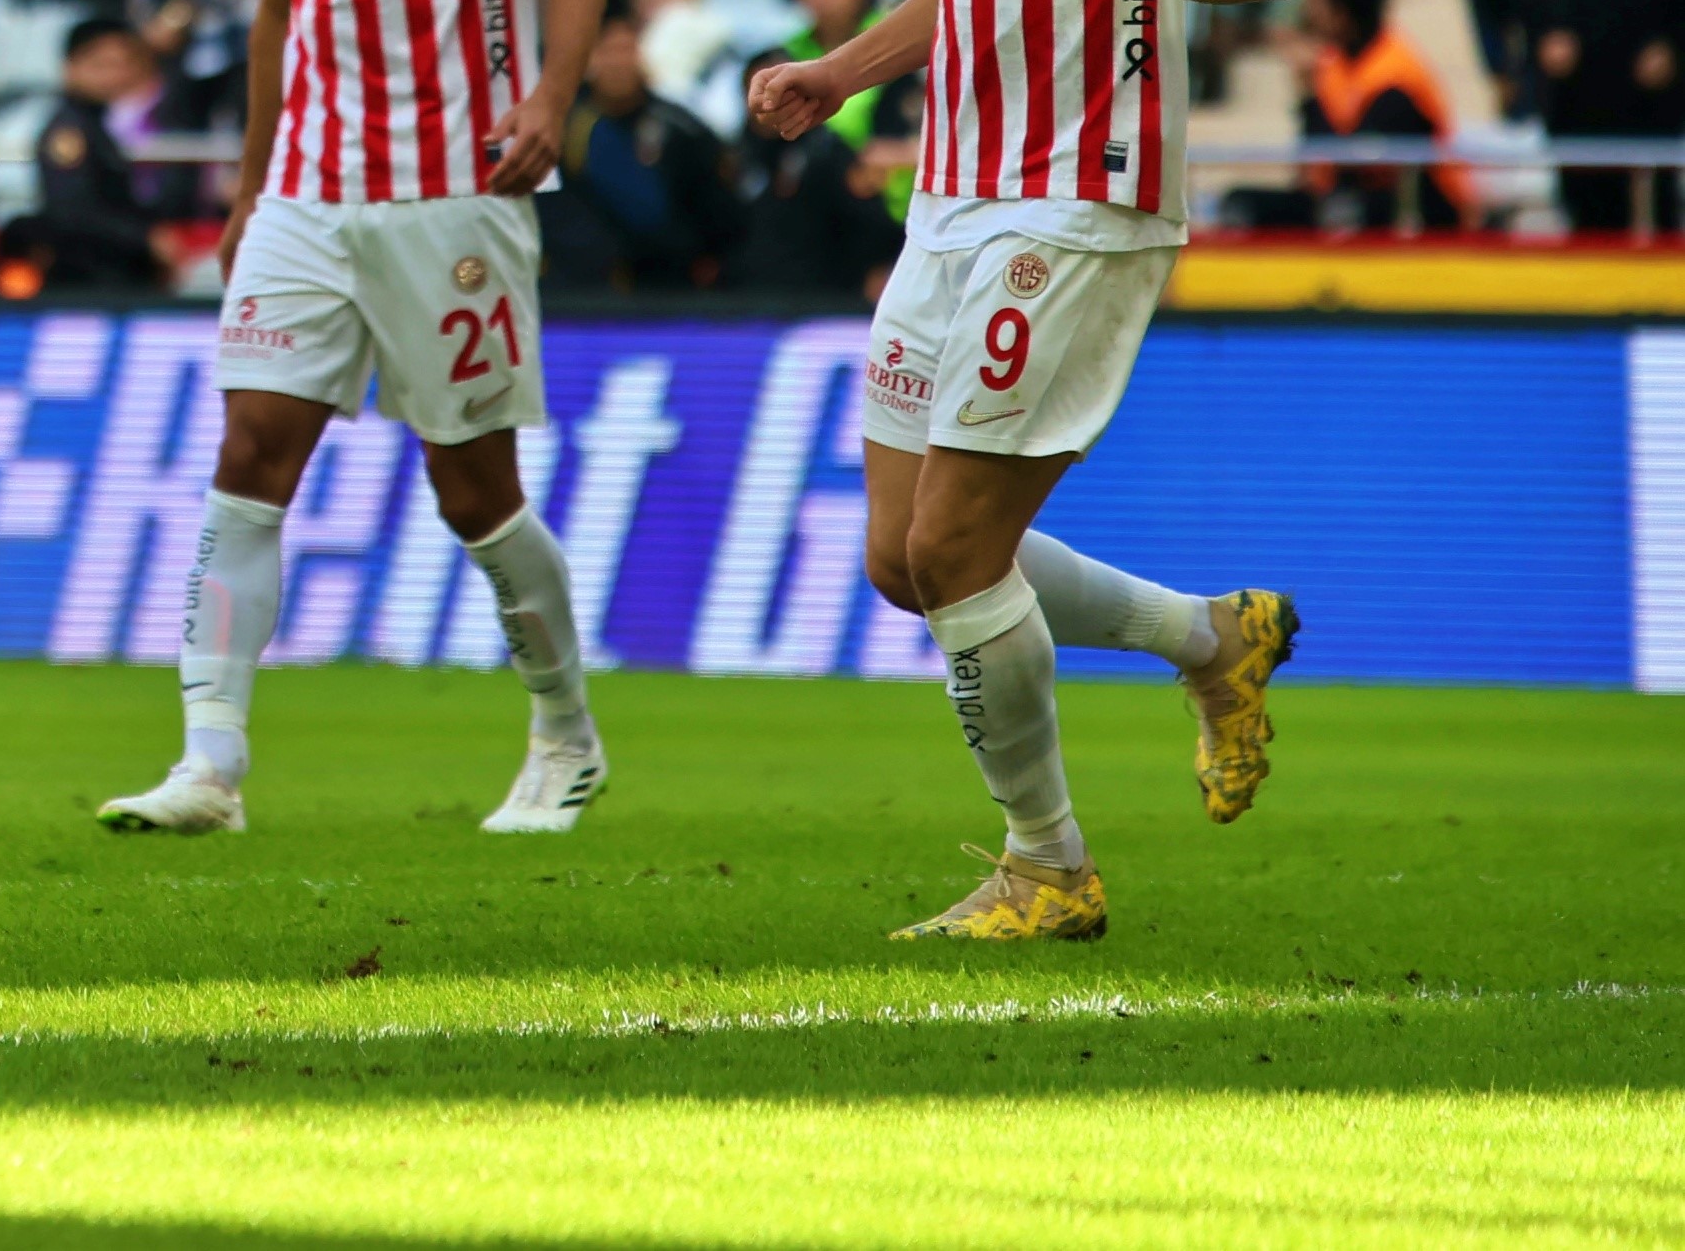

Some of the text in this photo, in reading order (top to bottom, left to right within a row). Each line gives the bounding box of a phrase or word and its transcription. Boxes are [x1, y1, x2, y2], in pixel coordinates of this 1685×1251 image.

[439, 293, 523, 384] 21
[979, 307, 1031, 392] 9
[47, 312, 685, 676] Rent
[949, 649, 986, 718] bitex
